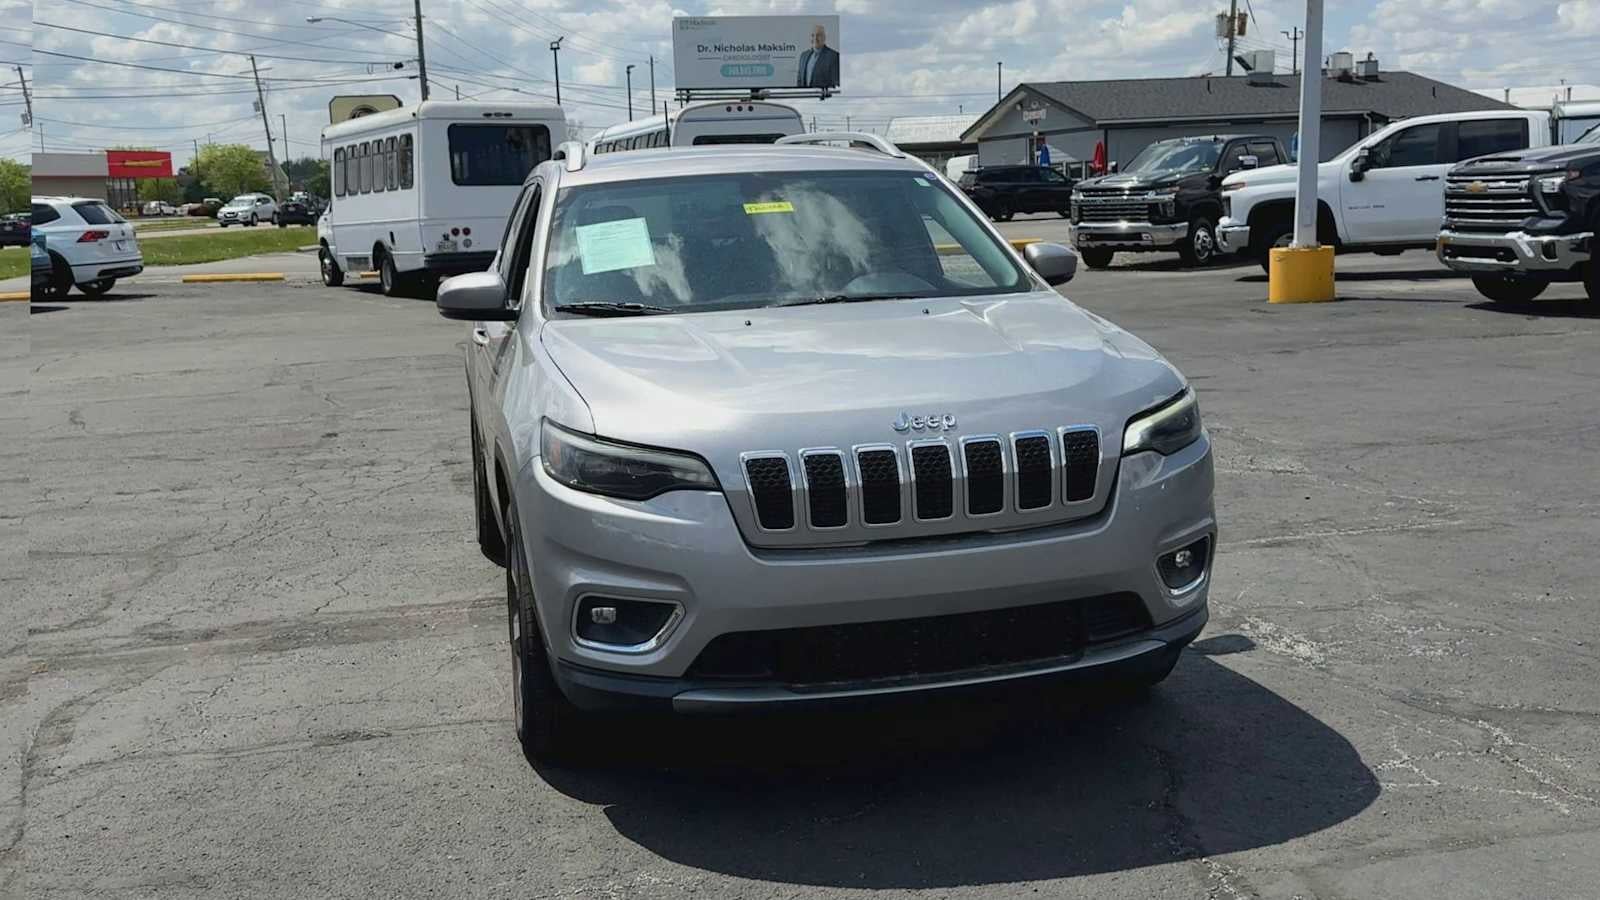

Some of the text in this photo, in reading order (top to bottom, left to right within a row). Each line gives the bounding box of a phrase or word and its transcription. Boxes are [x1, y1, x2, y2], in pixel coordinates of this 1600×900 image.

[697, 42, 797, 53] Dr. Nicholas Maksim
[893, 412, 957, 432] Jeep
